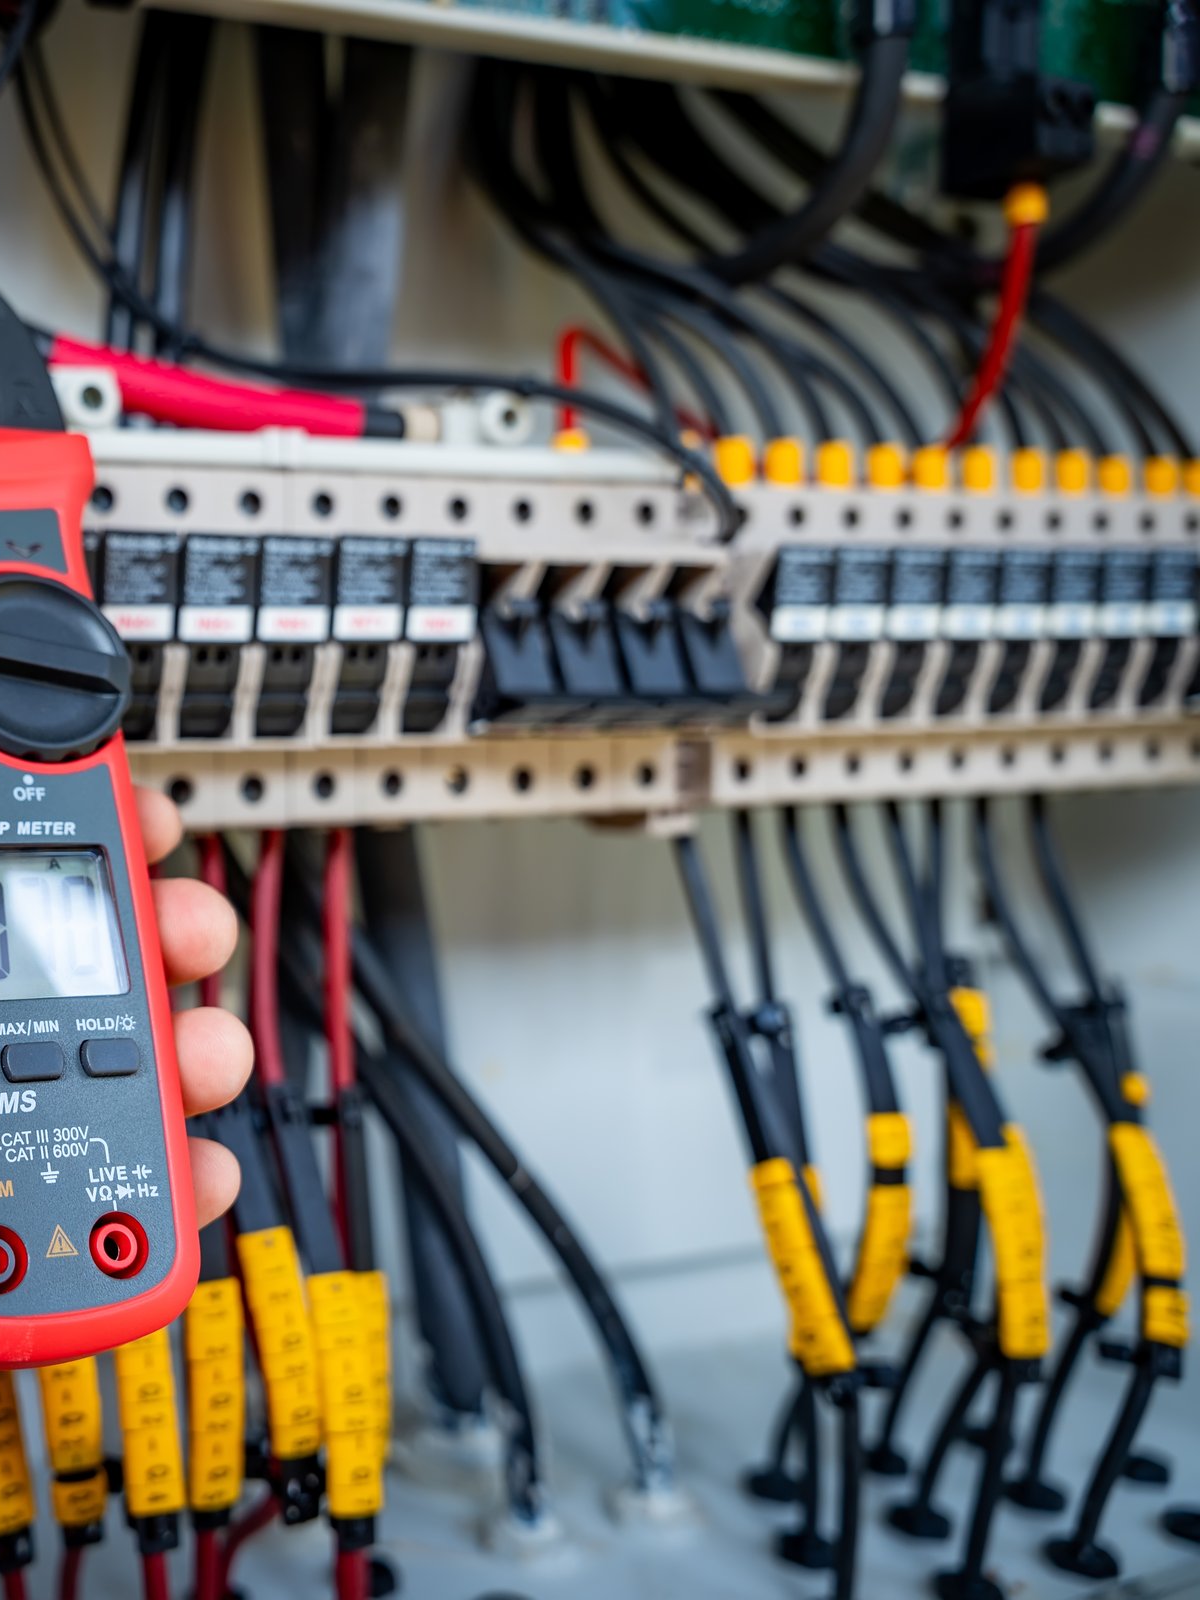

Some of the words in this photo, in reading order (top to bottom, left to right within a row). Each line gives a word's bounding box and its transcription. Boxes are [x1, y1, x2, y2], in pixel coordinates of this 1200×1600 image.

[12, 786, 46, 802] OFF
[17, 821, 77, 836] METER
[1, 1131, 31, 1146] CAT
[36, 1128, 49, 1143] III
[53, 1125, 89, 1142] 300V
[5, 1146, 36, 1162] CAT
[40, 1145, 49, 1159] II
[52, 1141, 89, 1159] 600V
[88, 1165, 128, 1183] LIVE
[137, 1182, 159, 1198] Hz
